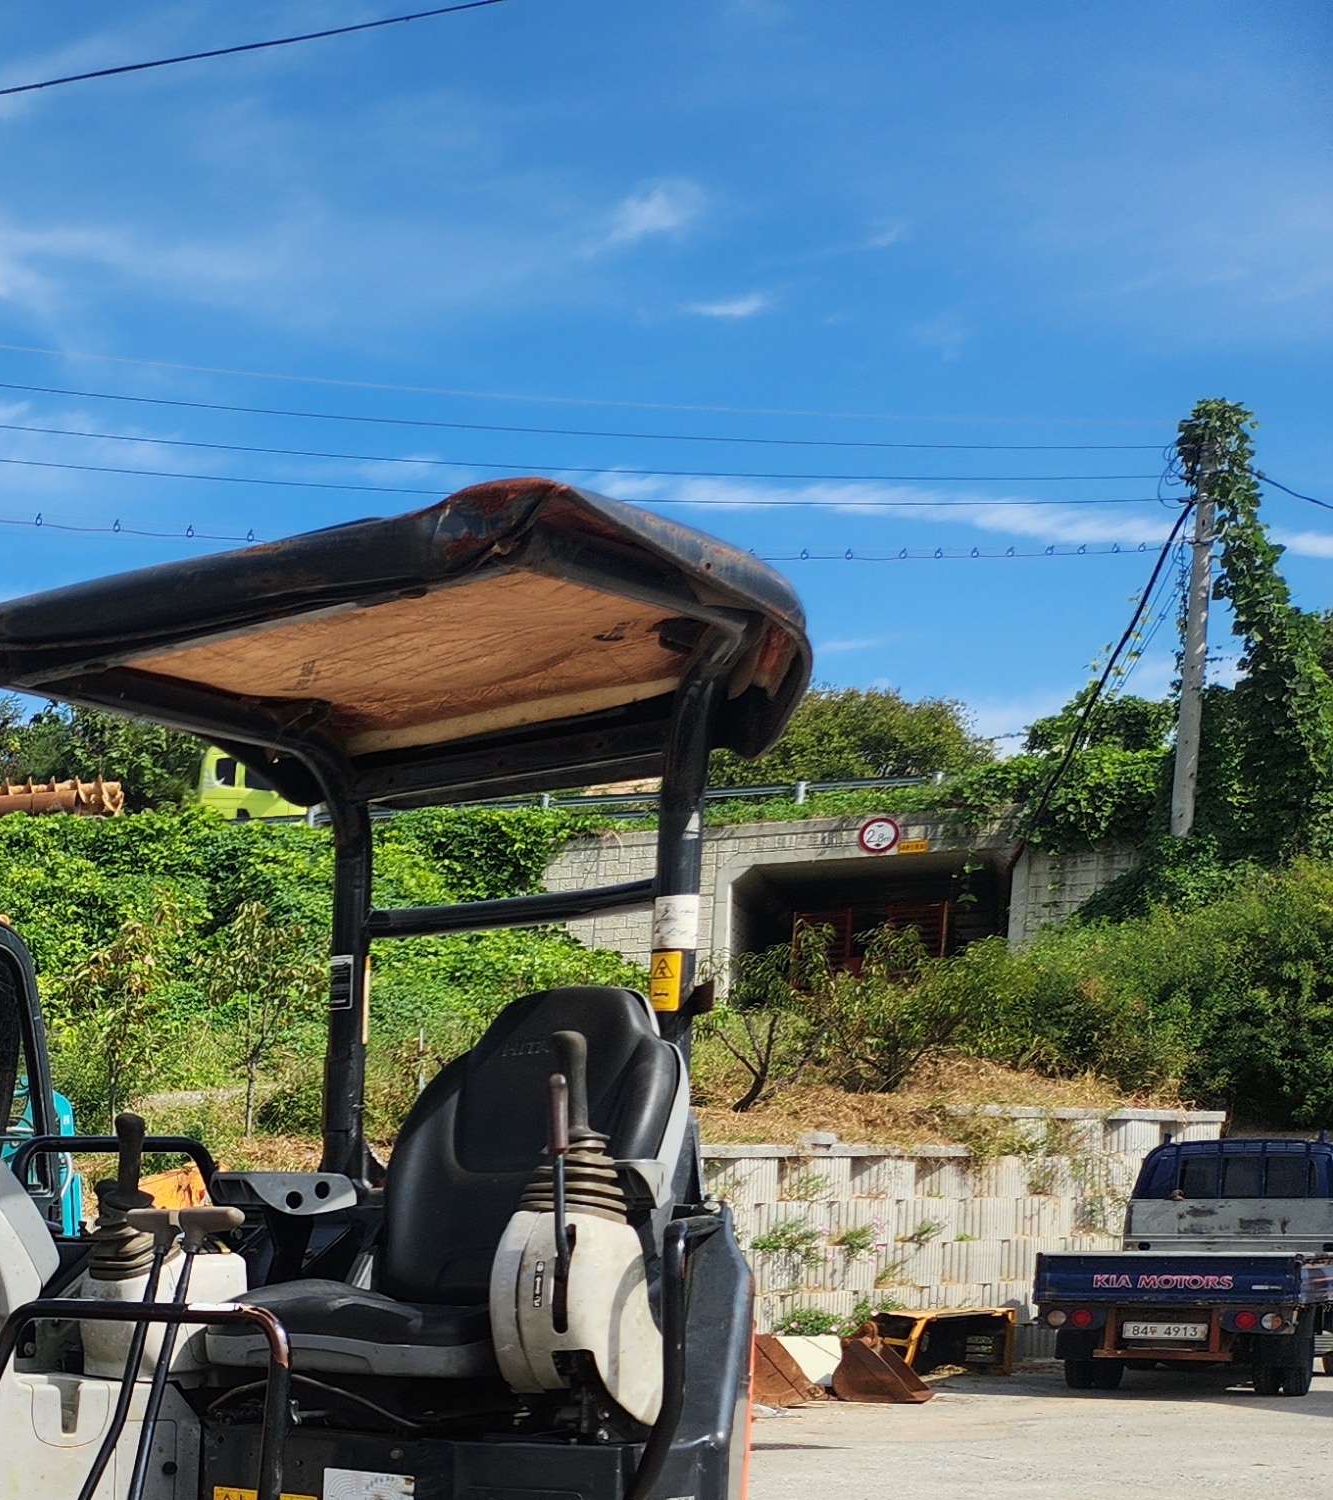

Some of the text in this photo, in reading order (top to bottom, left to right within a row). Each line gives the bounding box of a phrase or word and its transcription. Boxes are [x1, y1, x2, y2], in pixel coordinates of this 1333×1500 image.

[1093, 1274, 1233, 1289] KIA MOTORS
[1163, 1326, 1198, 1337] 4913
